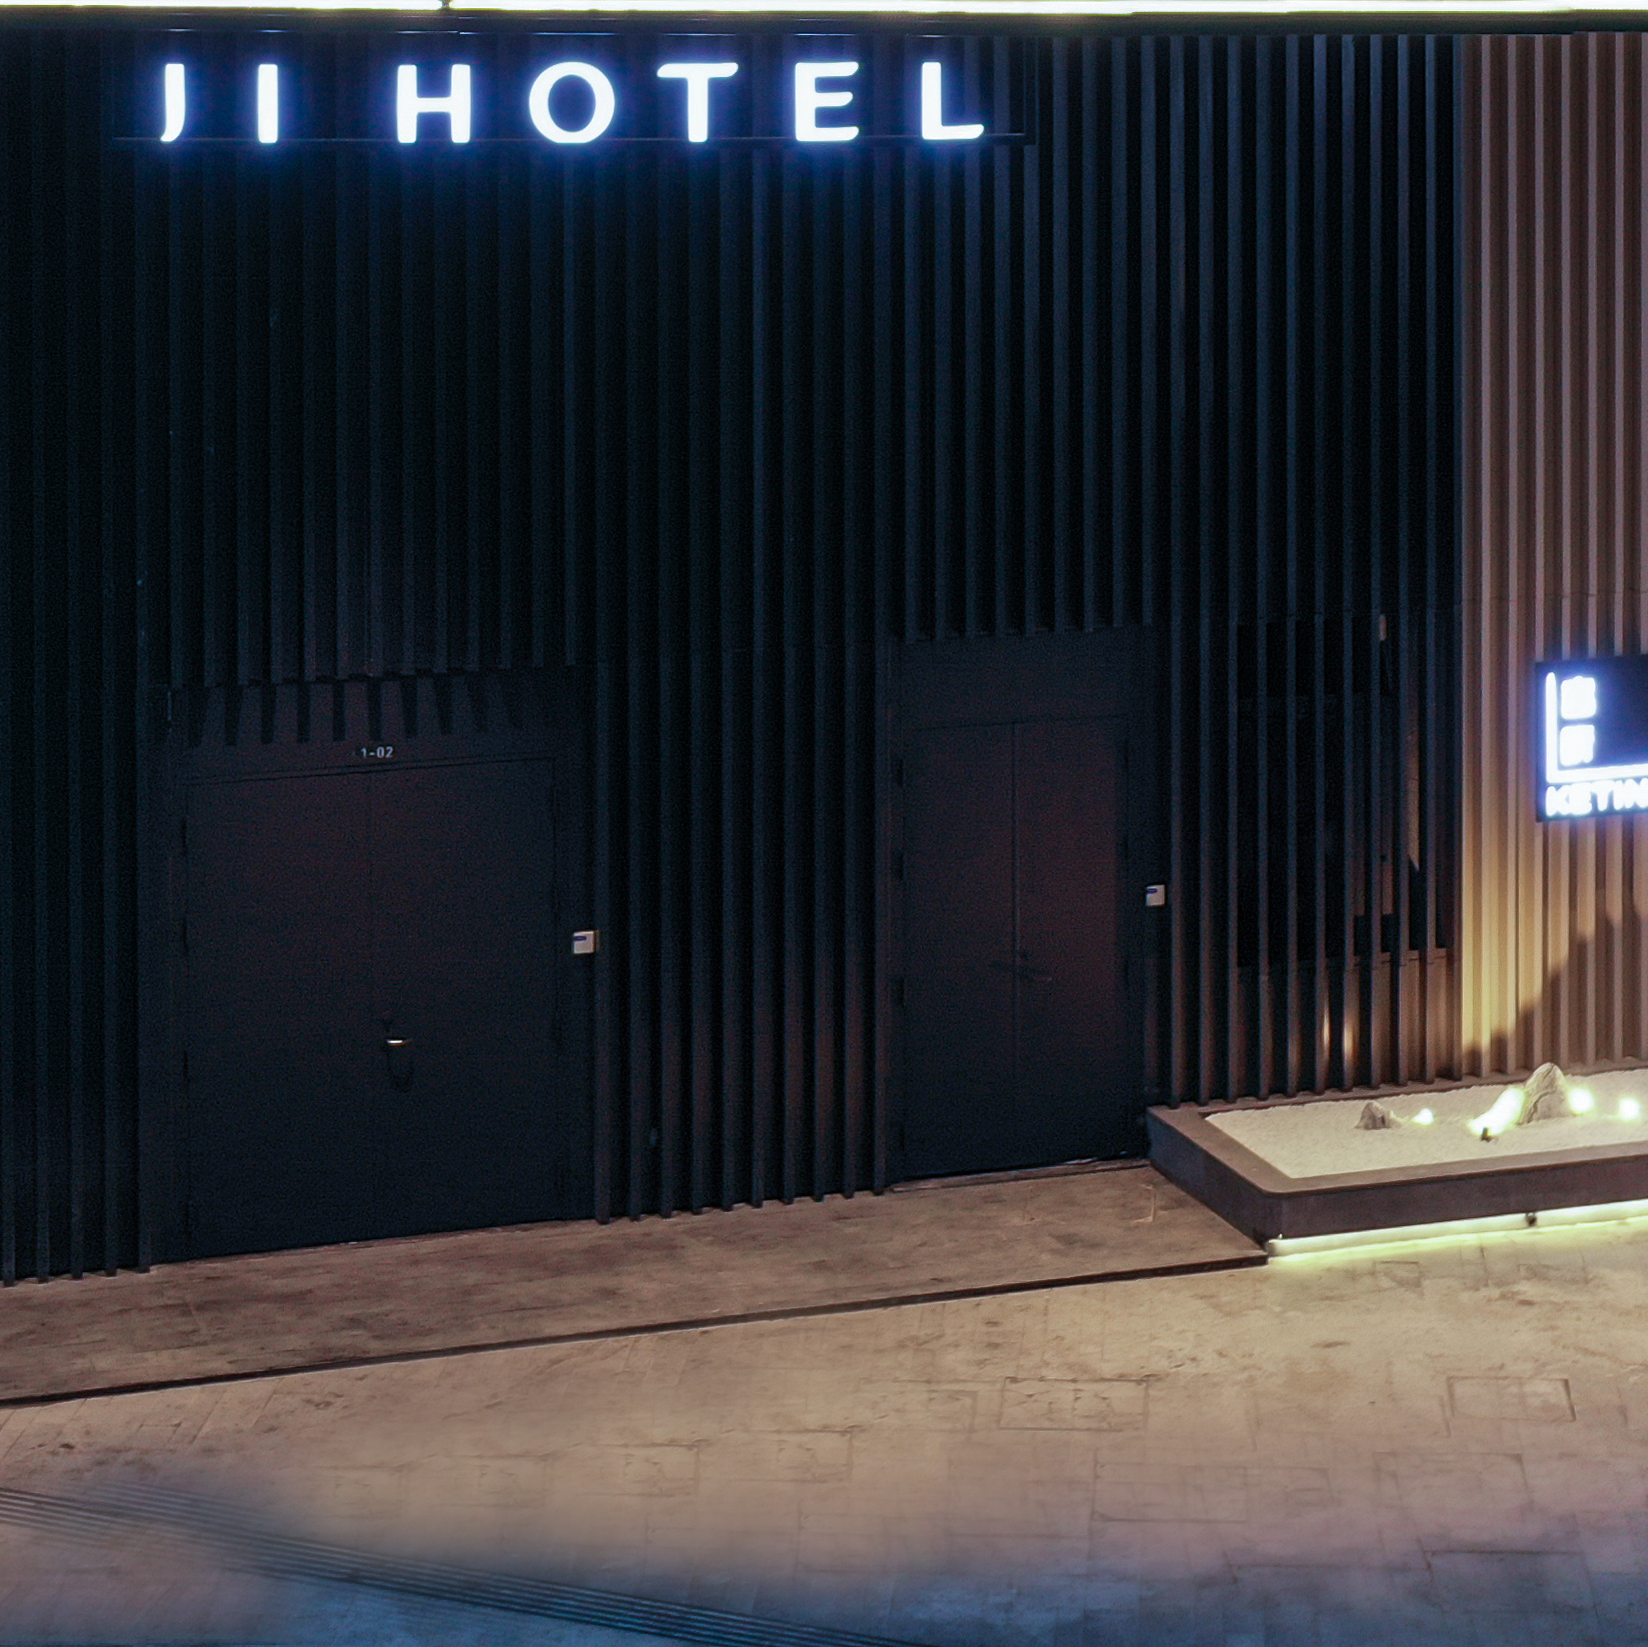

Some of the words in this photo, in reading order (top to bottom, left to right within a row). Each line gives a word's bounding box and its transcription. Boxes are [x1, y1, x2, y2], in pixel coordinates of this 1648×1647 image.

[159, 61, 280, 144] JI
[395, 61, 985, 144] HOTEL
[360, 746, 394, 759] 1-02
